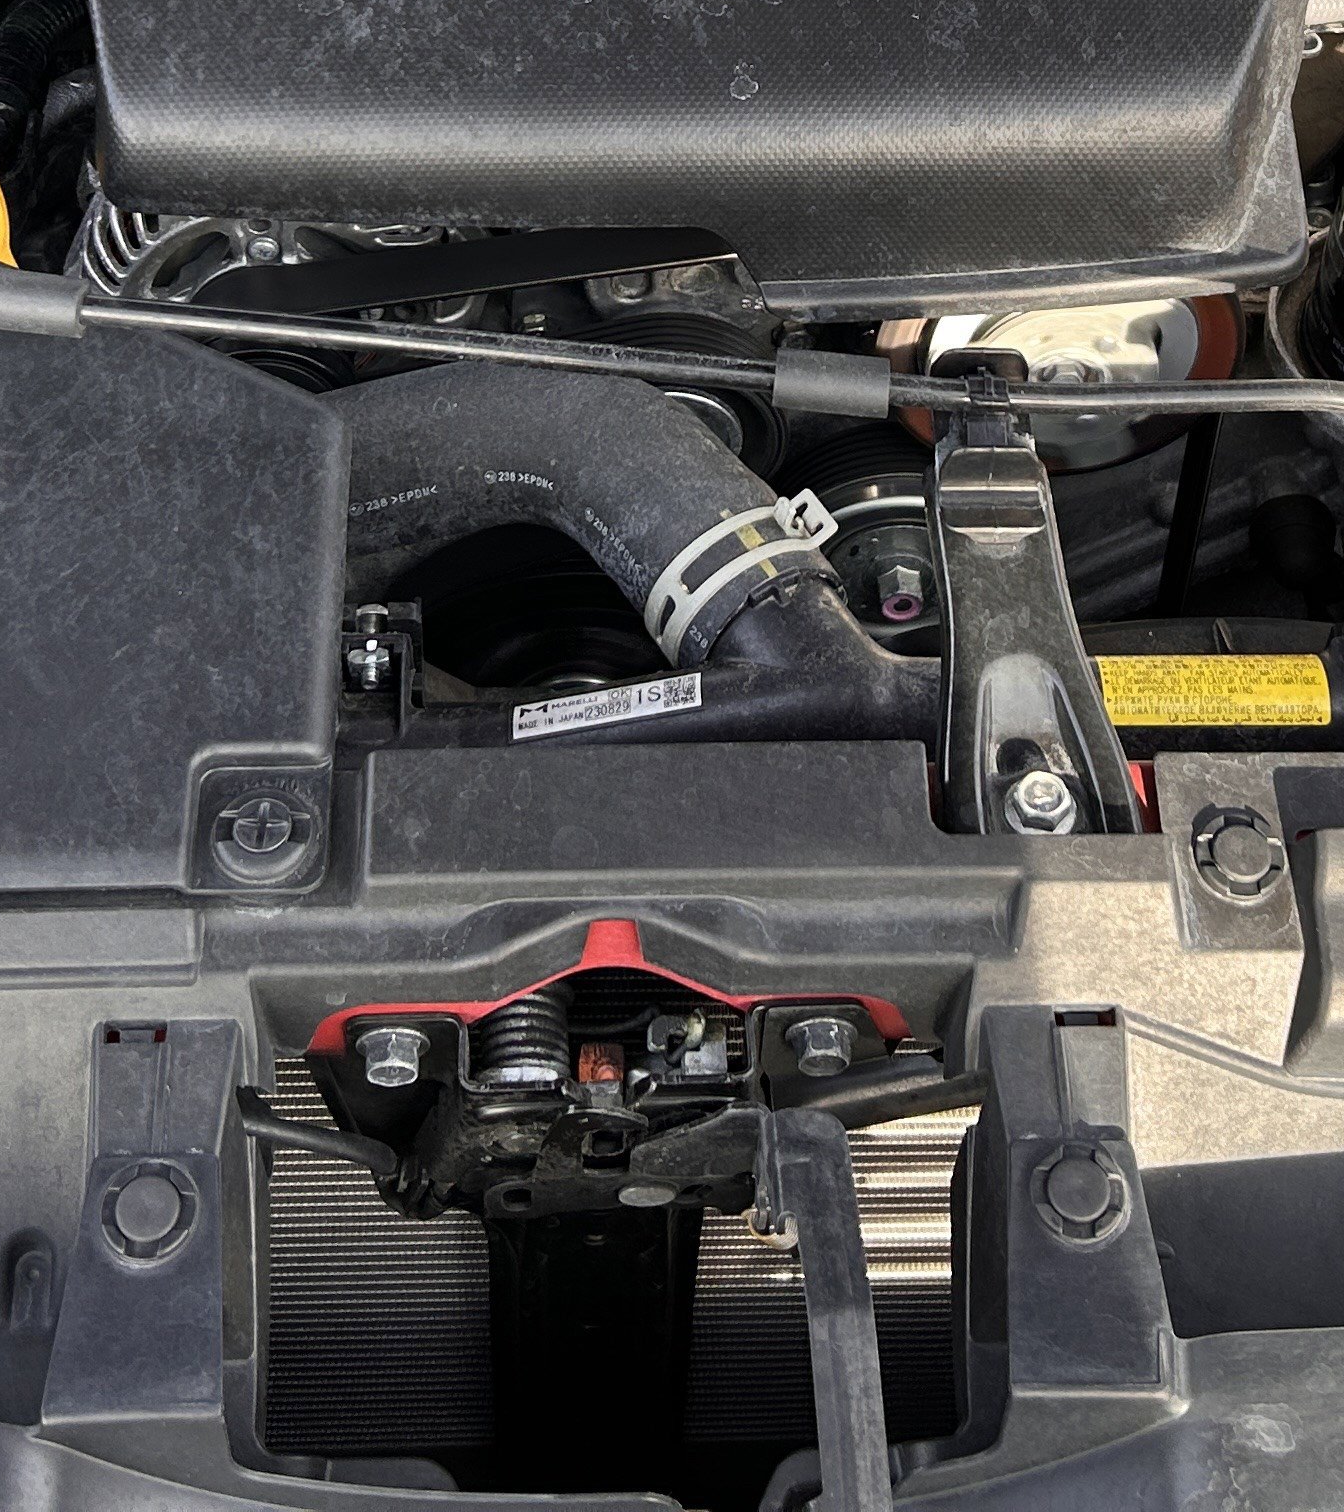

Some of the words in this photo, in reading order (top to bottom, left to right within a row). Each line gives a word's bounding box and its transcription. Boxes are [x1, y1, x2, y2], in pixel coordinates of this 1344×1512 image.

[551, 695, 599, 710] MARELLI
[518, 719, 538, 731] MADE
[544, 716, 554, 726] IN
[558, 712, 585, 723] JAPAN
[585, 700, 631, 720] 230829
